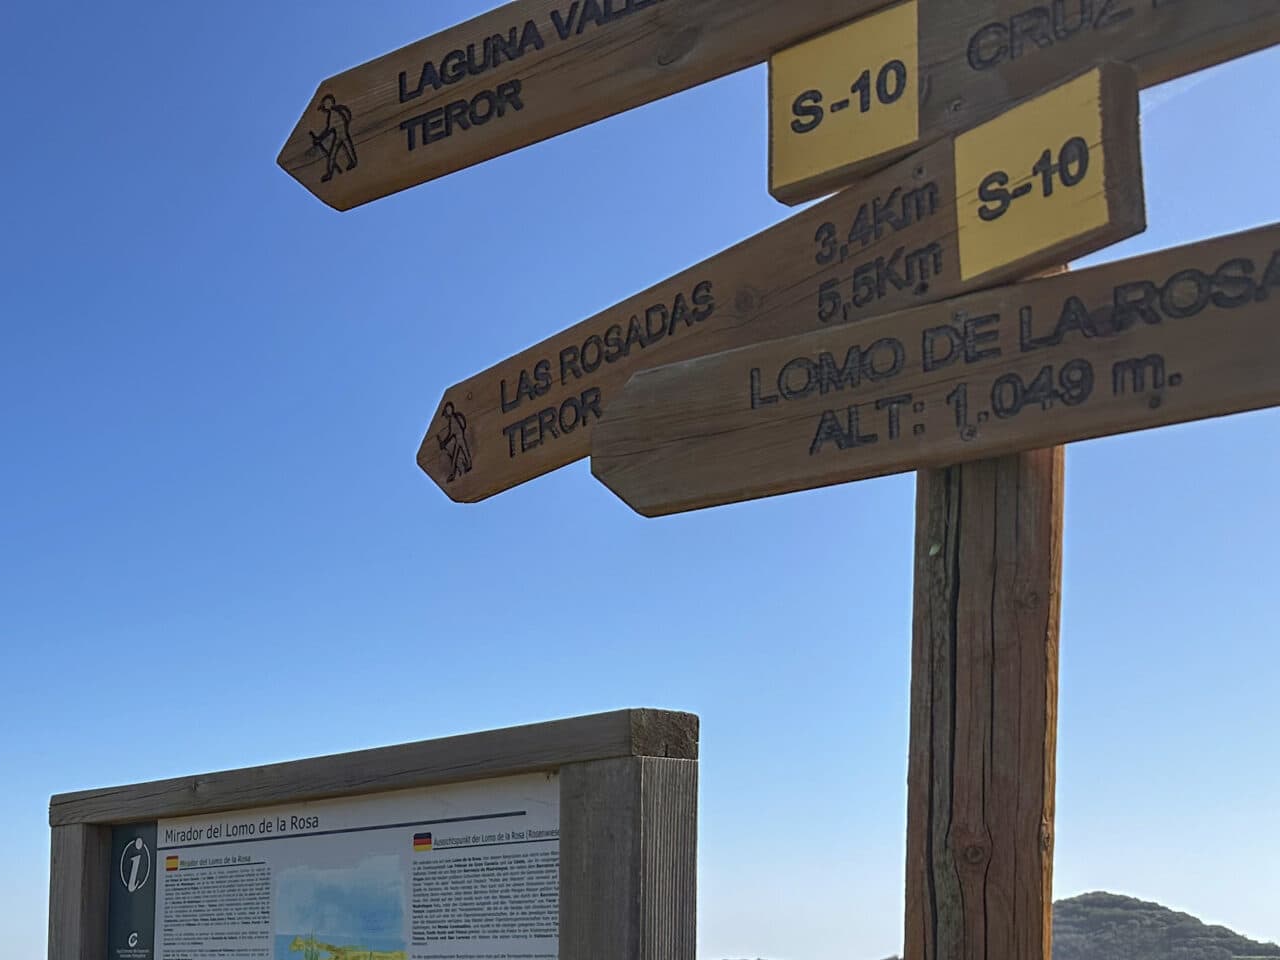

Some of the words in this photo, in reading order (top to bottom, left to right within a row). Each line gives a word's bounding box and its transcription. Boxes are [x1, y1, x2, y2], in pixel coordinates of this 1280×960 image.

[399, 20, 545, 103] LAGUNA
[791, 59, 908, 134] S-10
[399, 78, 524, 152] TEROR
[977, 136, 1090, 221] S-10
[499, 359, 552, 414] LAS
[559, 280, 715, 386] ROSADAS
[814, 177, 939, 266] 3,4Km
[502, 386, 603, 458] TEROR
[817, 238, 944, 324] 5,5Km
[750, 337, 906, 410] LOMO
[922, 312, 1001, 373] DE
[1020, 295, 1099, 353] LA
[809, 393, 926, 456] ALT:
[946, 357, 1095, 429] 1.049
[165, 825, 203, 843] Mirador
[206, 823, 222, 839] del
[226, 822, 256, 837] Lomo
[259, 818, 273, 833] de
[277, 817, 286, 831] la
[291, 815, 319, 830] Rosa
[481, 833, 496, 842] Lomo
